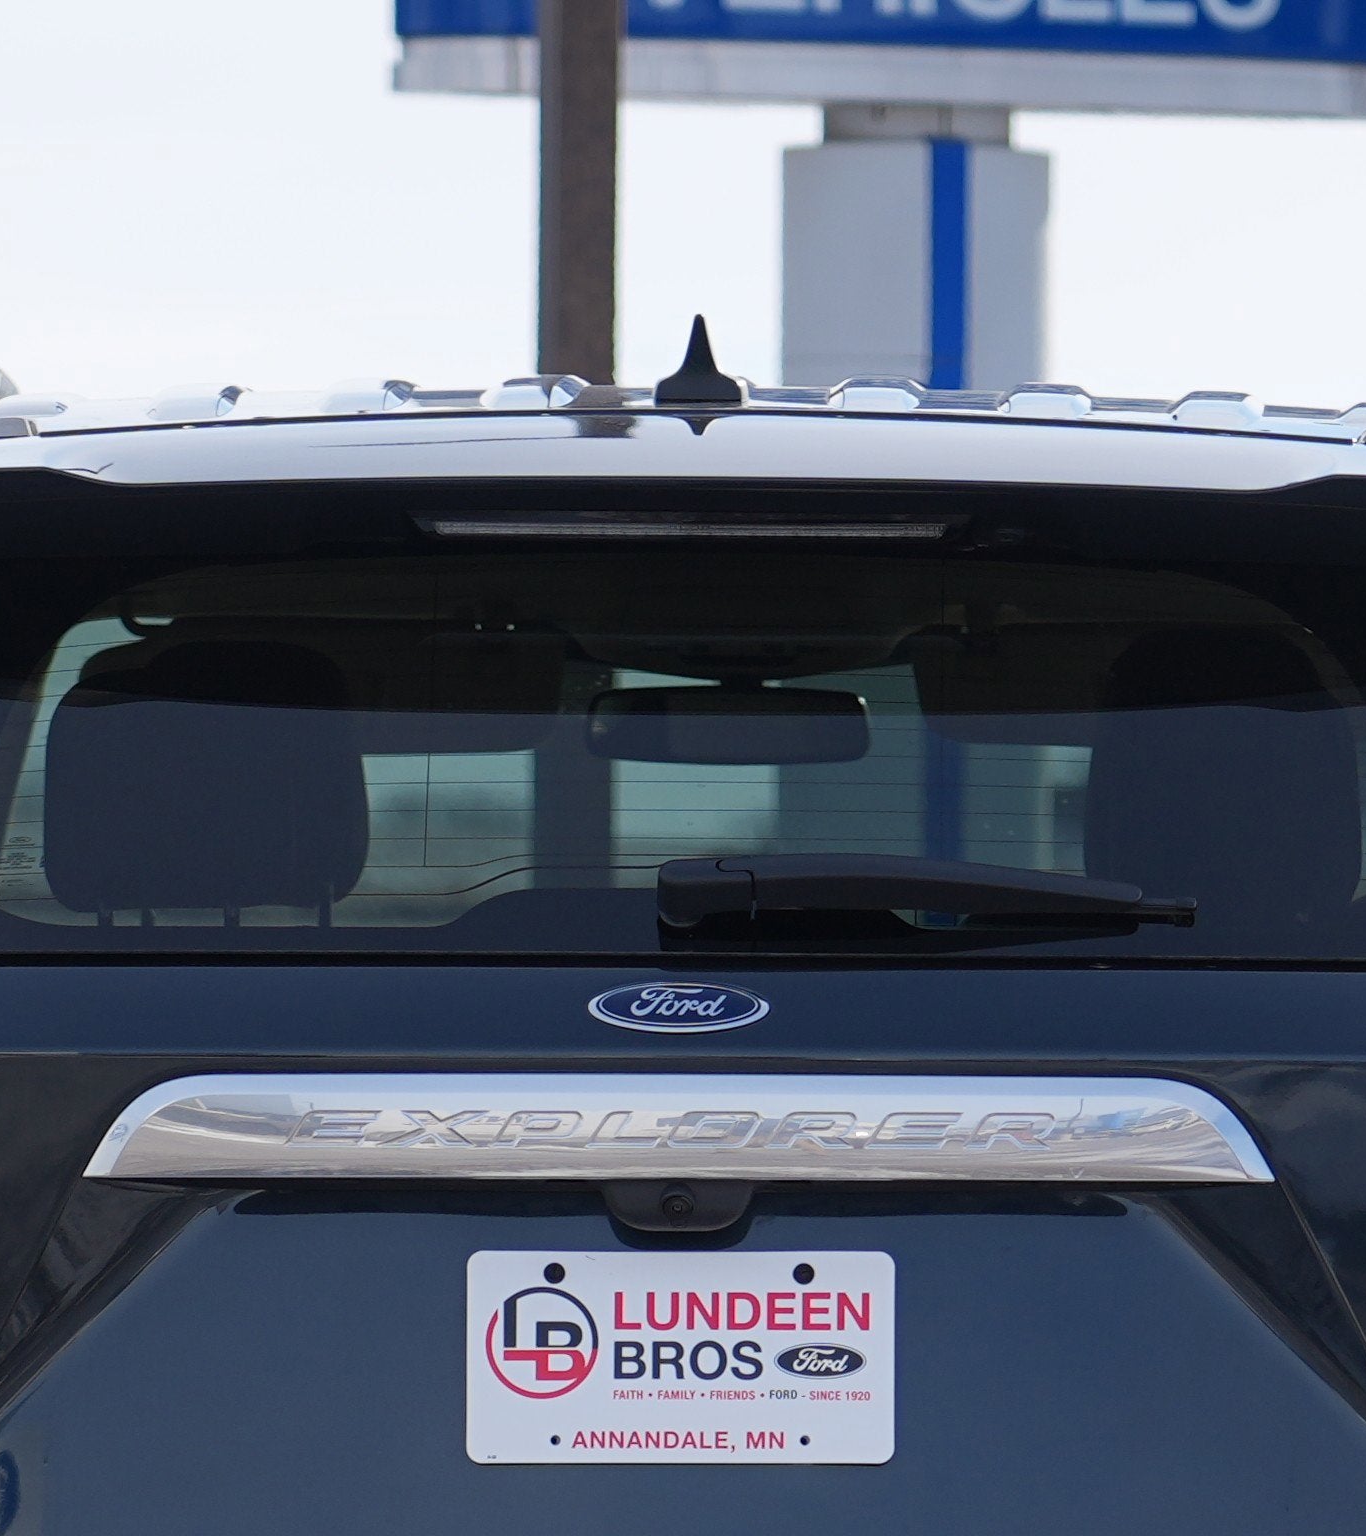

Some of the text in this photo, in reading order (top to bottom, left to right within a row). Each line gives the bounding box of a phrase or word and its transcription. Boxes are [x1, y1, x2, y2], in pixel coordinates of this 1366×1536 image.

[630, 987, 727, 1017] Ford
[284, 1108, 1056, 1151] EXPLORER
[613, 1291, 871, 1331] LUNDEEN
[613, 1340, 764, 1380] BROS
[792, 1347, 850, 1372] Ford
[612, 1389, 871, 1401] FAITH FAMILY FRIENDS FORD SINCE 1920
[571, 1431, 785, 1453] ANNANDALE, MN
